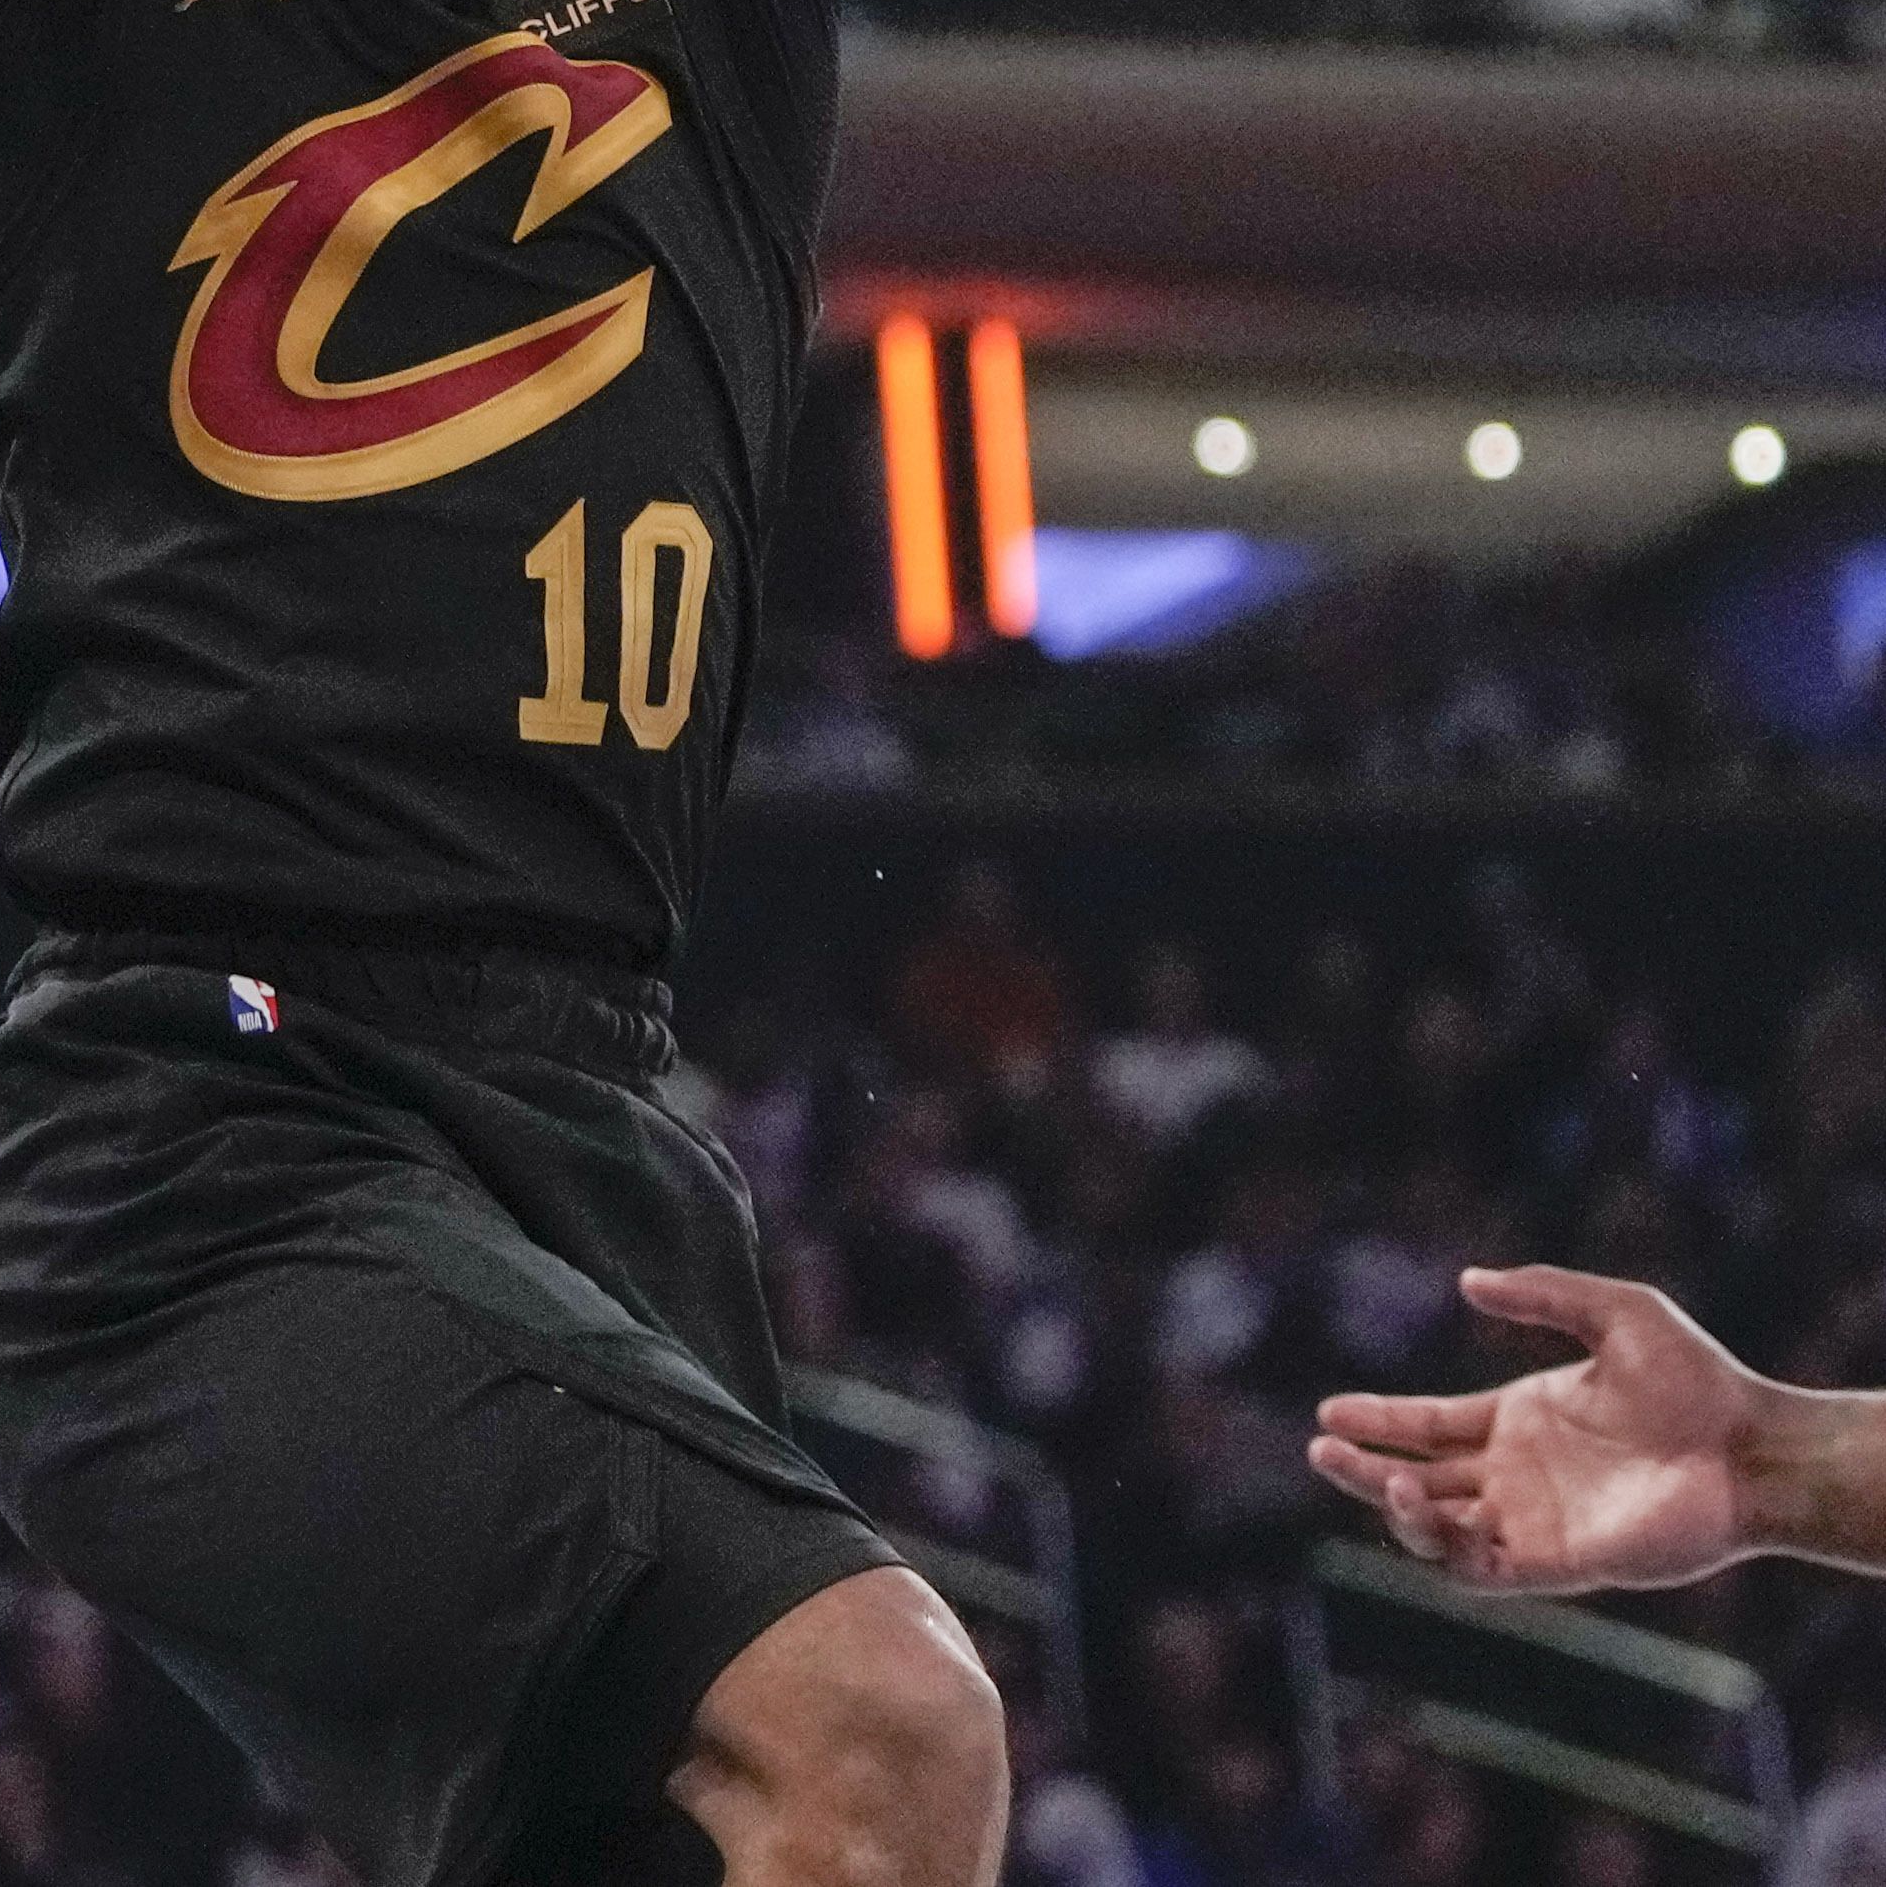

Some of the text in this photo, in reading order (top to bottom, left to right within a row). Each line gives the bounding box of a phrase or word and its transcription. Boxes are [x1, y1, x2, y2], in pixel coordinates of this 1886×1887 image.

[168, 32, 672, 502] C
[519, 499, 713, 750] 10
[238, 1012, 262, 1031] NBA
